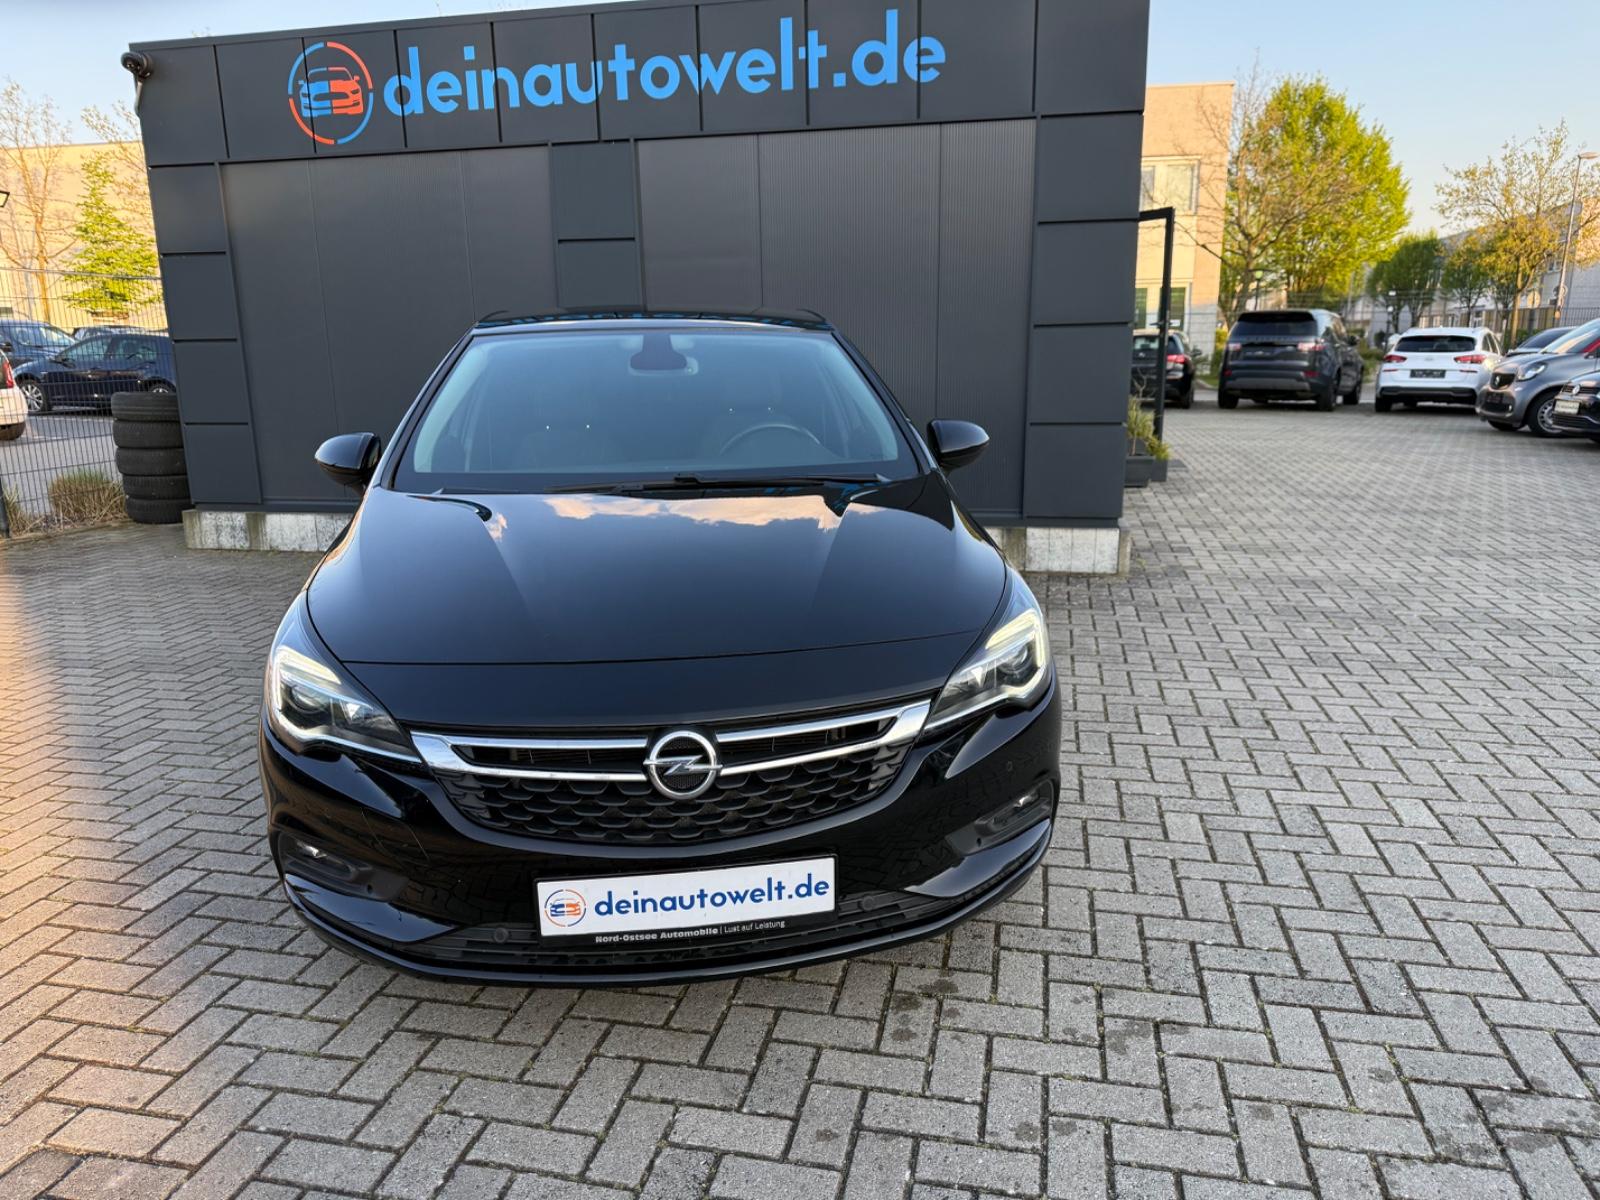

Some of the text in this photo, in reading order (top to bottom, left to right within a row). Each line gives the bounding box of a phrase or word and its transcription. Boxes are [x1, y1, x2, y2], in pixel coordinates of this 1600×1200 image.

[383, 9, 947, 117] deinautowelt.de
[594, 873, 830, 917] deinautowelt.de
[595, 920, 786, 944] Nord-Ostsee Automobile Lust auf Leistung
